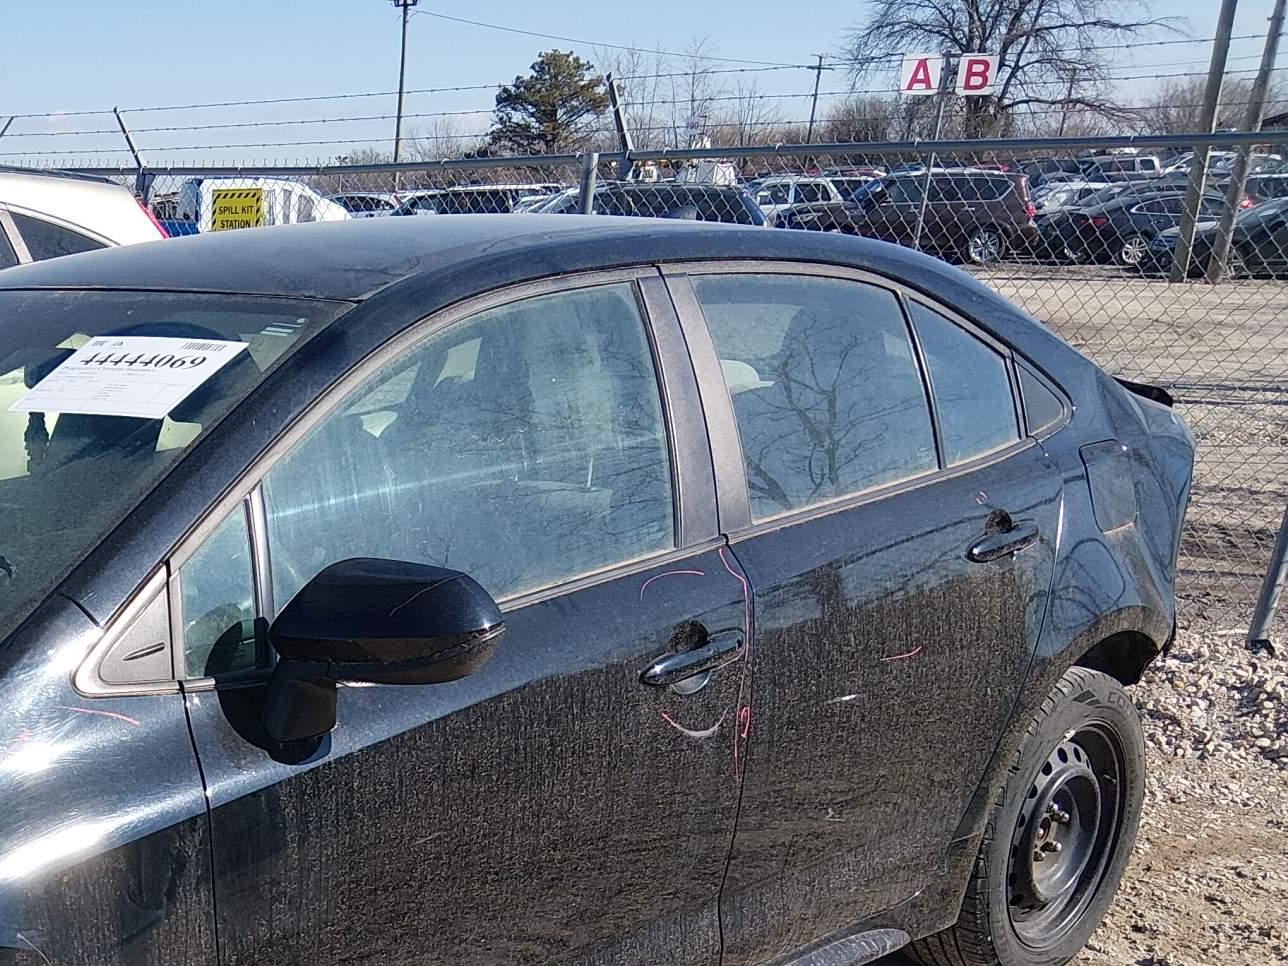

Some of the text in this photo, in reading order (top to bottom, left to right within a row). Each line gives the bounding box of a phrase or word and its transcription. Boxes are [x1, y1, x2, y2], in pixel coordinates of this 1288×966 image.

[906, 58, 990, 91] A B
[218, 205, 254, 215] SPILL KIT
[220, 219, 251, 230] STATION
[79, 351, 208, 370] 44444069
